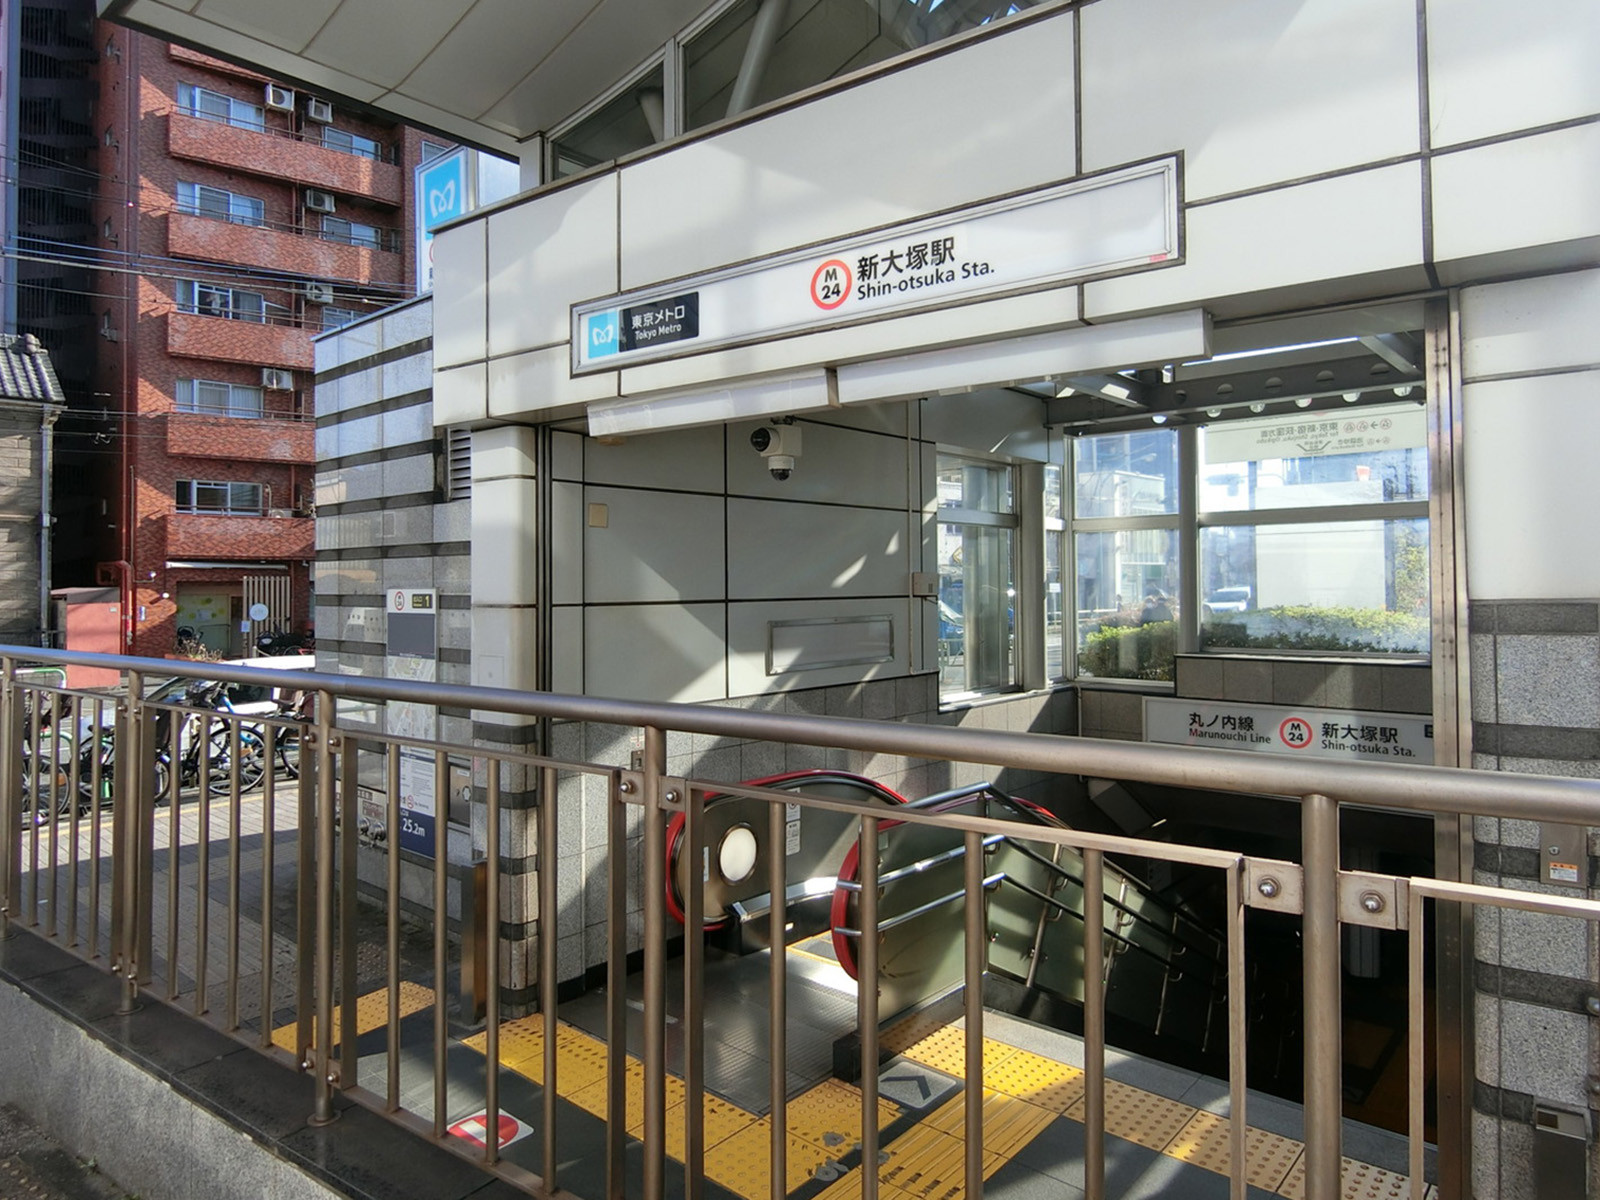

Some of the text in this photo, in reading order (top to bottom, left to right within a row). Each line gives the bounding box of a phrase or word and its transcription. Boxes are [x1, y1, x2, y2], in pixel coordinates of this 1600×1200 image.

[857, 237, 955, 280] 新大塚駅
[824, 268, 838, 282] M
[857, 260, 995, 301] Shin-otsuka Sta.
[821, 284, 841, 300] 24
[631, 305, 685, 329] 東京メトロ
[635, 324, 682, 341] Tokyo Metro
[425, 595, 430, 607] 1
[1188, 712, 1254, 731] 丸ノ内線
[1290, 722, 1301, 731] M
[1188, 728, 1271, 744] Marunouchi Line
[1288, 731, 1304, 742] 24
[1322, 722, 1398, 743] 新大塚駅
[1322, 739, 1416, 758] Shin-otsuka Sta.
[402, 817, 426, 838] 25.2m
